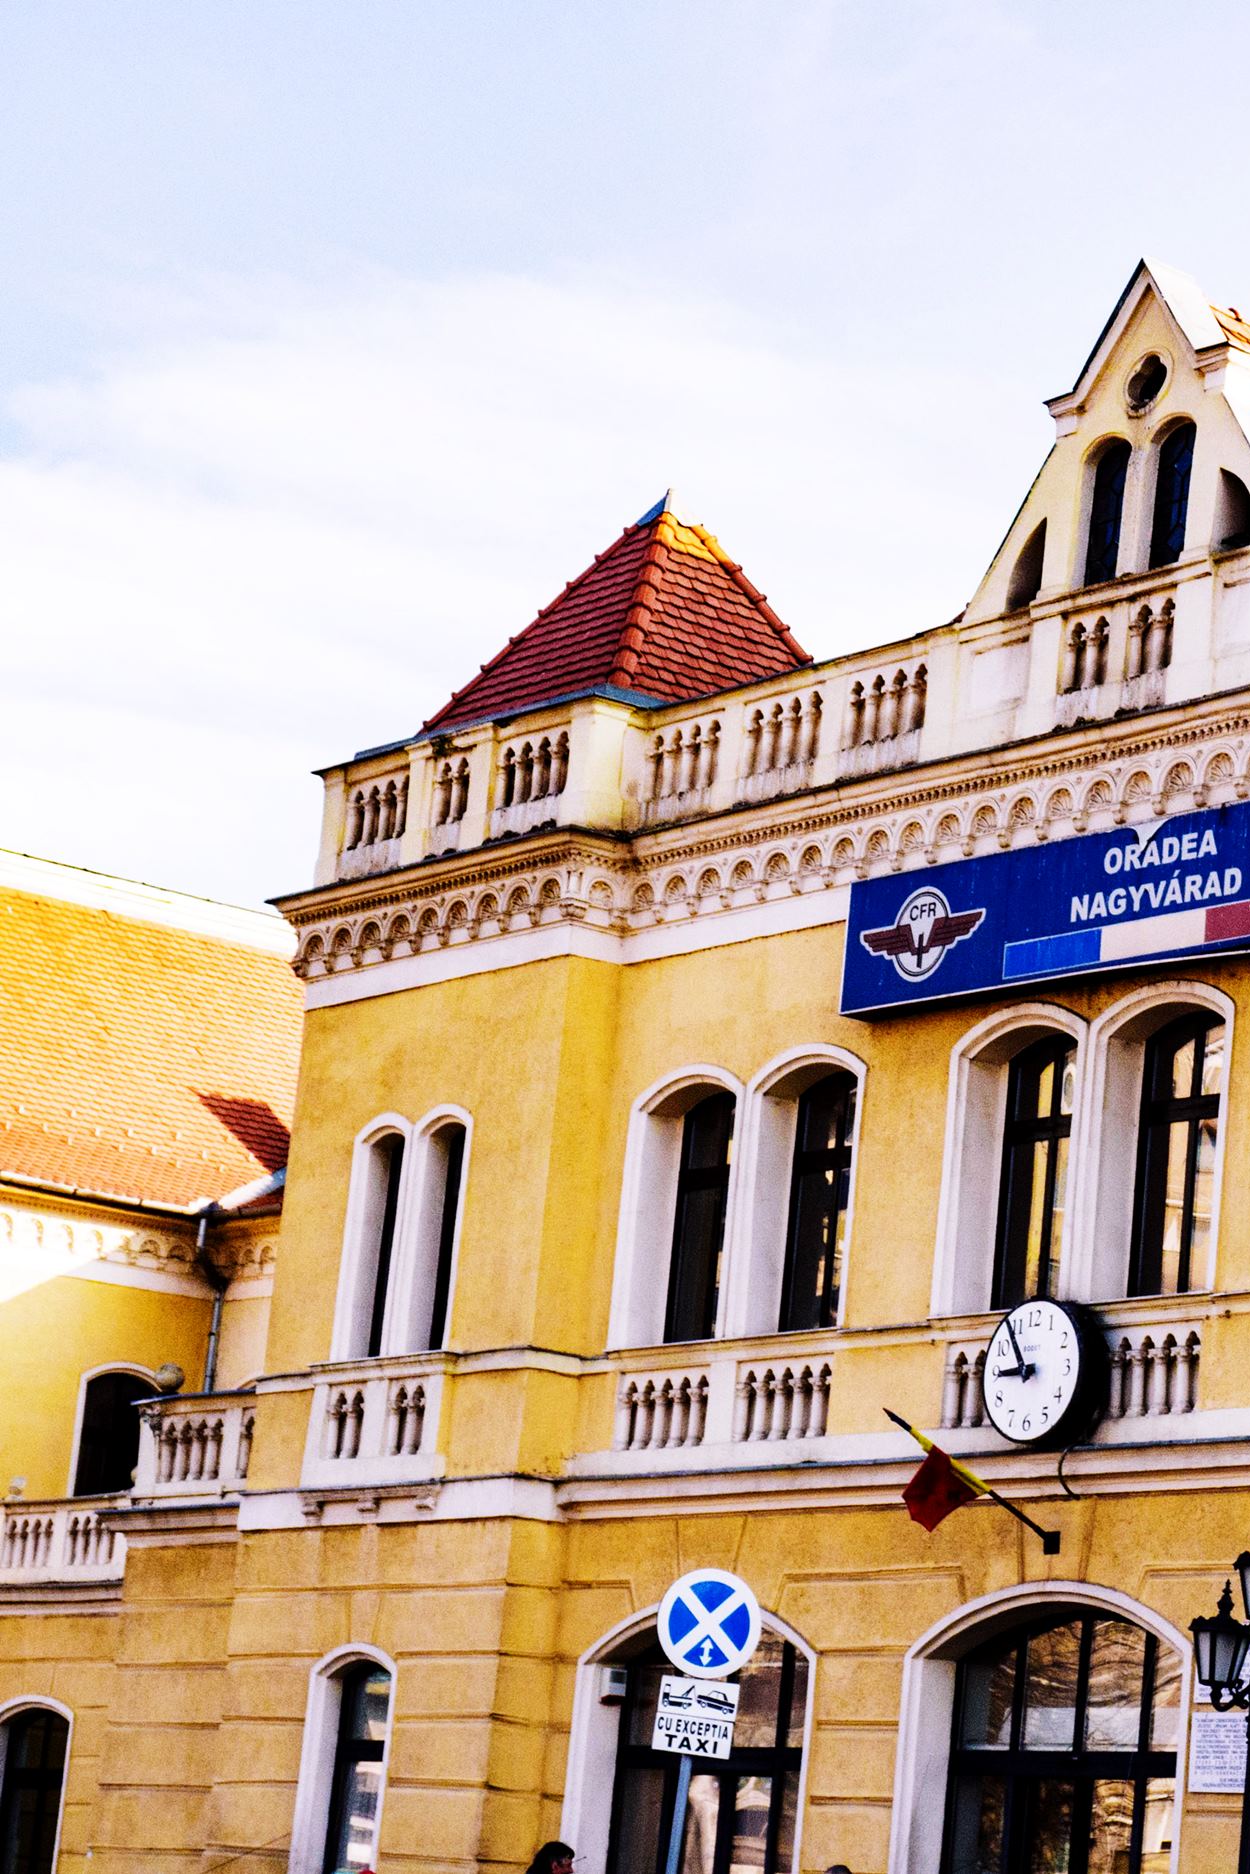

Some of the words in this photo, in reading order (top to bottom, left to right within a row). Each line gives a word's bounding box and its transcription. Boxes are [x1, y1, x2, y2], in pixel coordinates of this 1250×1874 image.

[1104, 829, 1217, 875] ORADEA
[1070, 867, 1242, 923] NAGYVÁRAD
[910, 902, 937, 921] CFR
[1012, 1318, 1023, 1335] 11
[1028, 1310, 1042, 1328] 12
[1048, 1315, 1054, 1331] 1
[997, 1339, 1010, 1357] 10
[1060, 1332, 1068, 1349] 2
[992, 1365, 1001, 1383] 9
[1063, 1359, 1071, 1376] 3
[994, 1391, 1003, 1408] 8
[1054, 1386, 1062, 1403] 4
[1008, 1410, 1015, 1428] 7
[1022, 1413, 1031, 1432] 6
[1040, 1406, 1048, 1424] 5
[657, 1716, 673, 1731] CU
[675, 1719, 728, 1740] EXCEPTIA
[665, 1733, 718, 1754] TAXI
